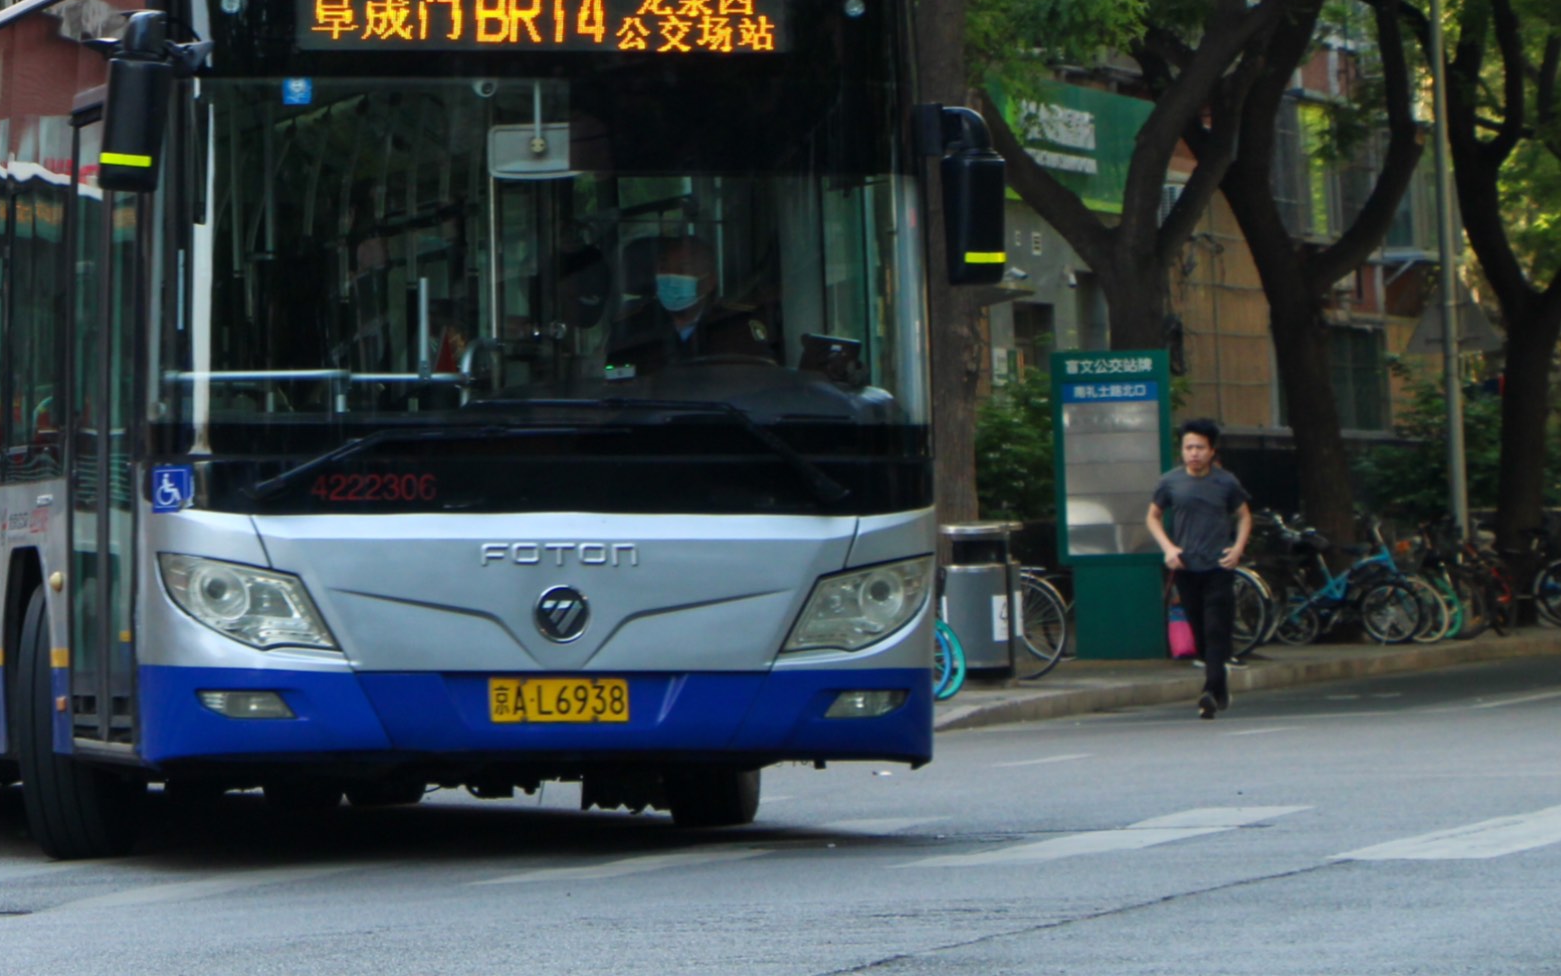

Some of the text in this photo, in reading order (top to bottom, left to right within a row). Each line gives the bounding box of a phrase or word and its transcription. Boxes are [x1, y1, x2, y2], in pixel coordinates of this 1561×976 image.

[615, 16, 776, 52] 公交场站
[1064, 357, 1154, 375] 盲文公交站牌
[1073, 384, 1147, 399] 南礼士路北口
[311, 473, 436, 501] 4222306
[481, 542, 639, 567] FOTON
